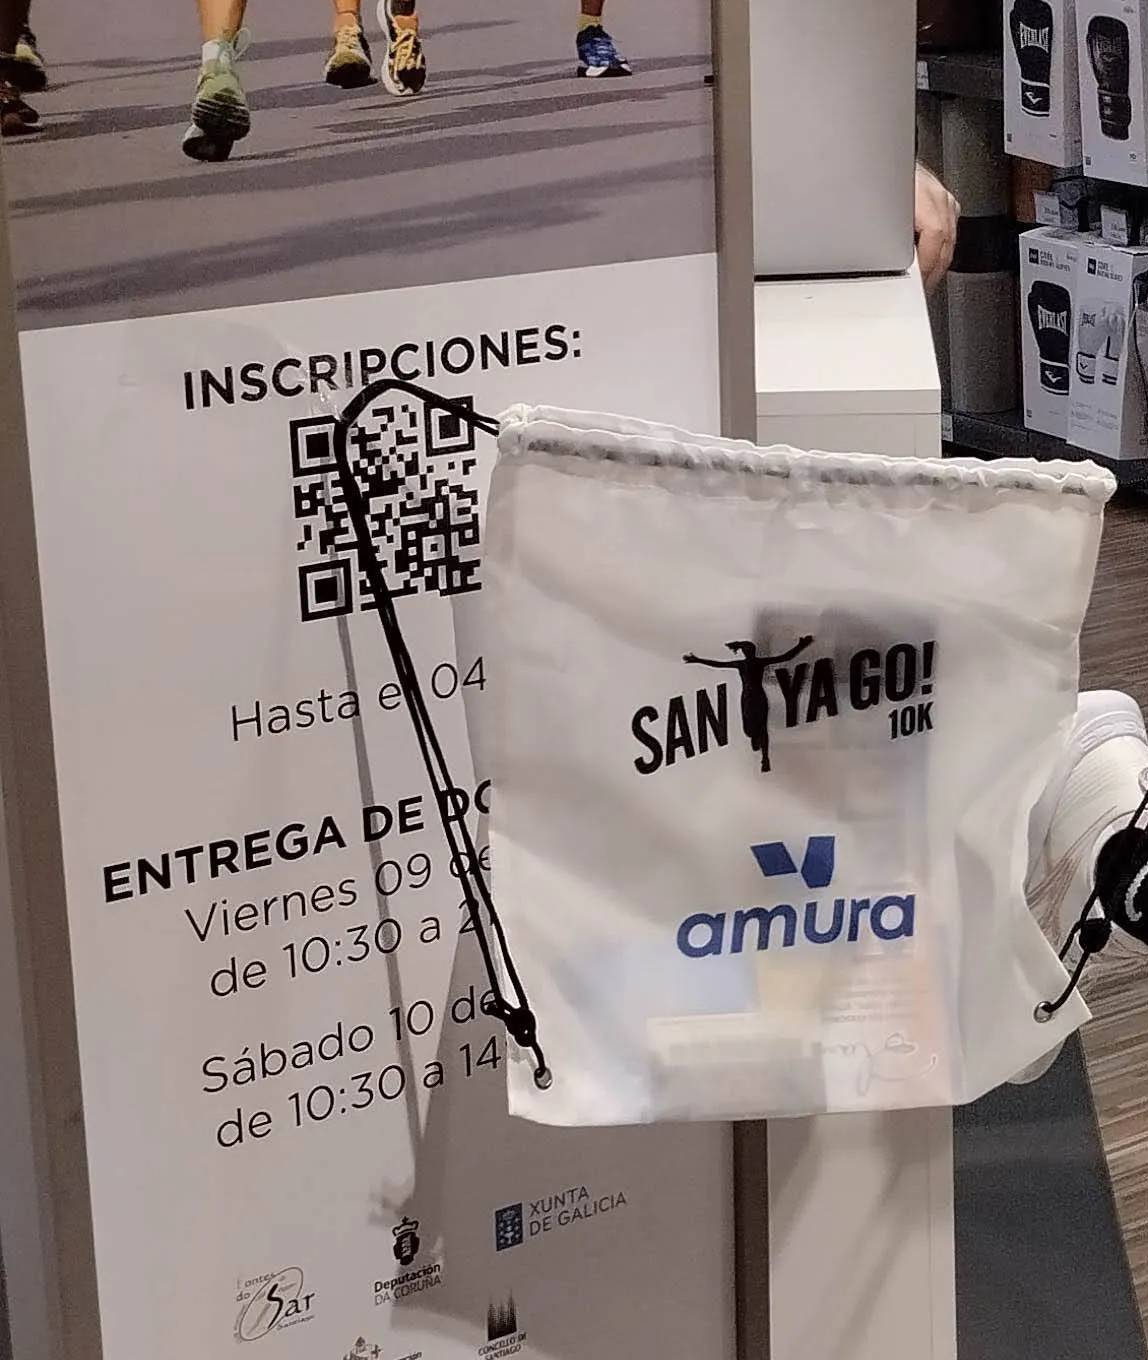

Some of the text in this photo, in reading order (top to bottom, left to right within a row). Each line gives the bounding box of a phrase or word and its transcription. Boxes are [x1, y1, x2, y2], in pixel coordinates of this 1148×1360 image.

[184, 324, 582, 409] INSCRIPCIONES:
[231, 688, 360, 742] Hasta
[432, 656, 487, 699] 04
[887, 701, 935, 740] 10K
[103, 816, 347, 902] ENTREGA
[363, 795, 424, 841] DE
[185, 877, 358, 943] Viernes
[375, 853, 431, 896] 09
[676, 894, 916, 958] amura
[209, 951, 267, 997] de
[282, 919, 402, 977] 10:30
[420, 916, 440, 943] a
[201, 1024, 374, 1095] Sábado
[390, 1001, 434, 1040] 10
[217, 1098, 273, 1148] de
[289, 1065, 406, 1126] 10:30
[423, 1061, 444, 1089] a
[529, 1186, 590, 1218] XUNTA
[529, 1192, 627, 1237] DE GALICIA
[374, 1264, 441, 1293] Deputación
[394, 1276, 442, 1301] CORUÑA
